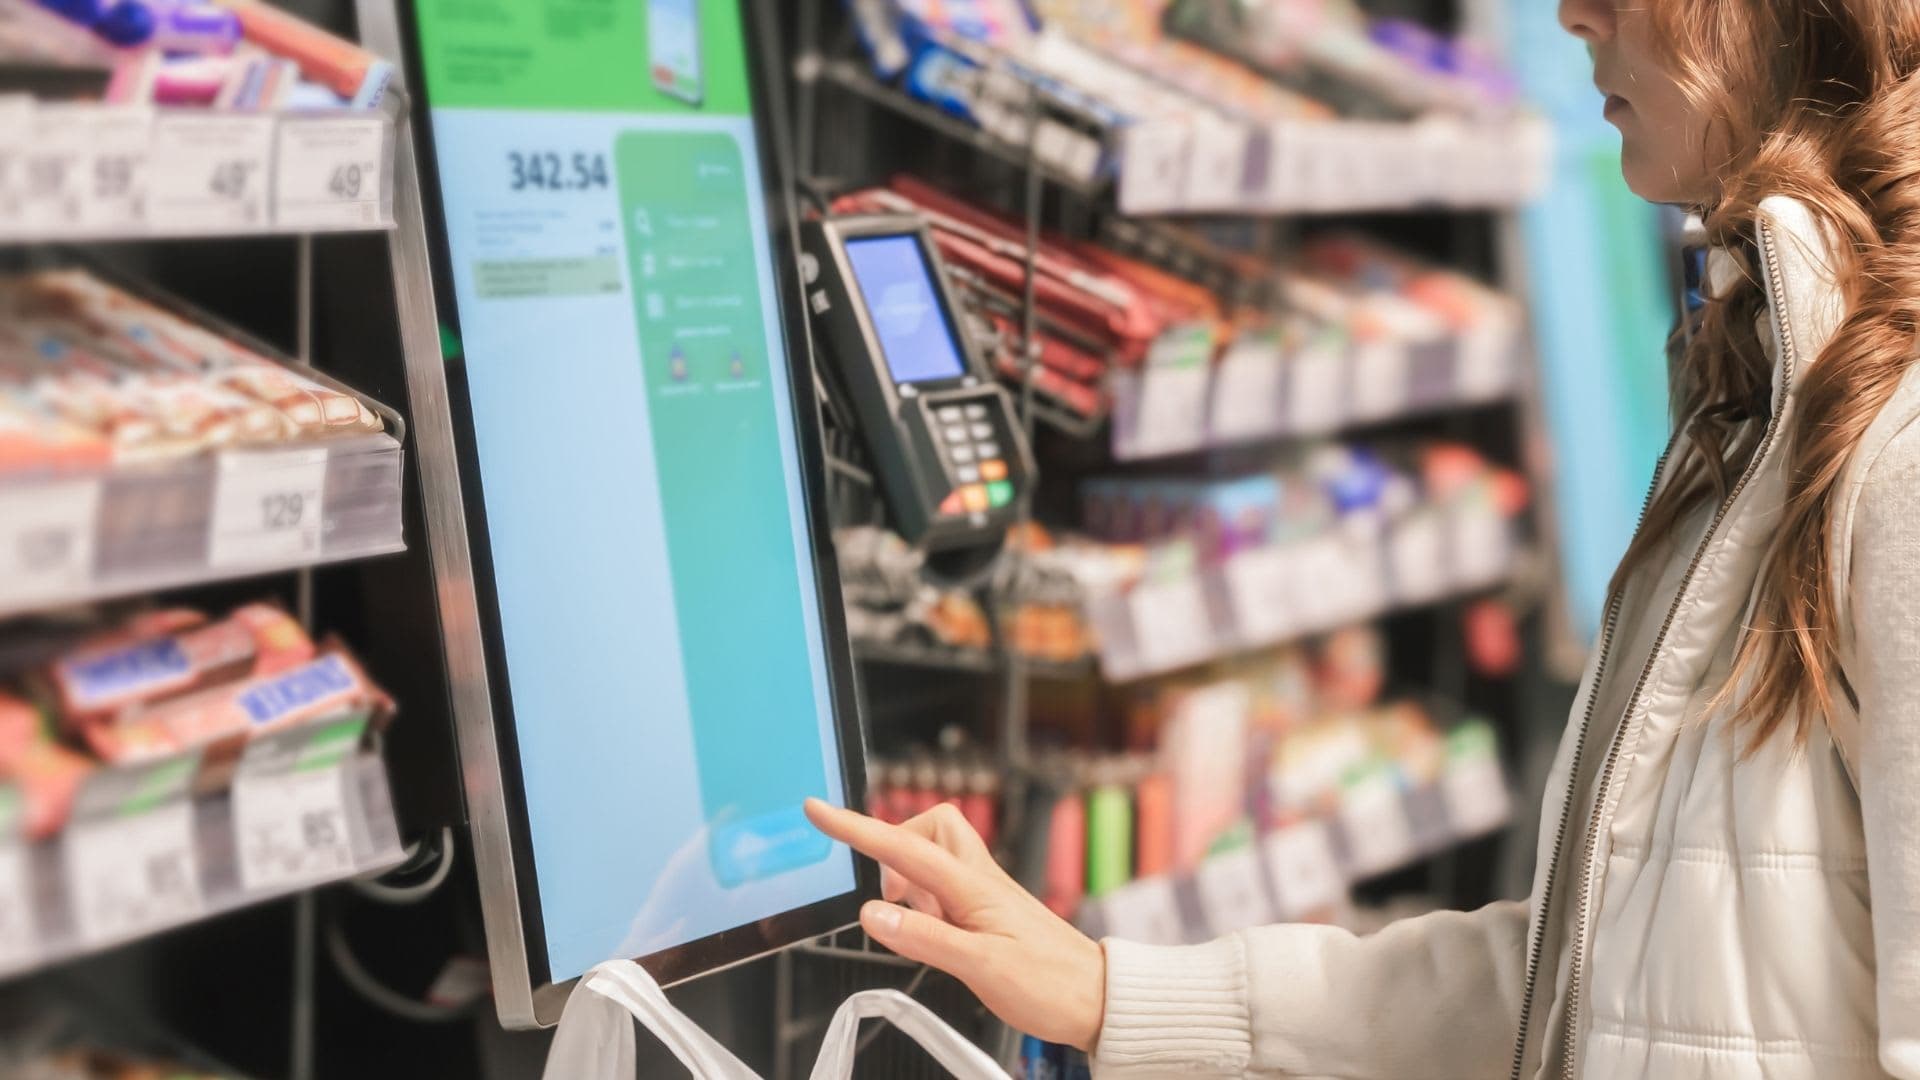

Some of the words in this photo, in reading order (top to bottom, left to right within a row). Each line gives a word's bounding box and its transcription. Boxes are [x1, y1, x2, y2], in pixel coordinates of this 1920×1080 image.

[329, 163, 361, 198] 49
[508, 151, 608, 191] 342.54
[261, 491, 303, 531] 129
